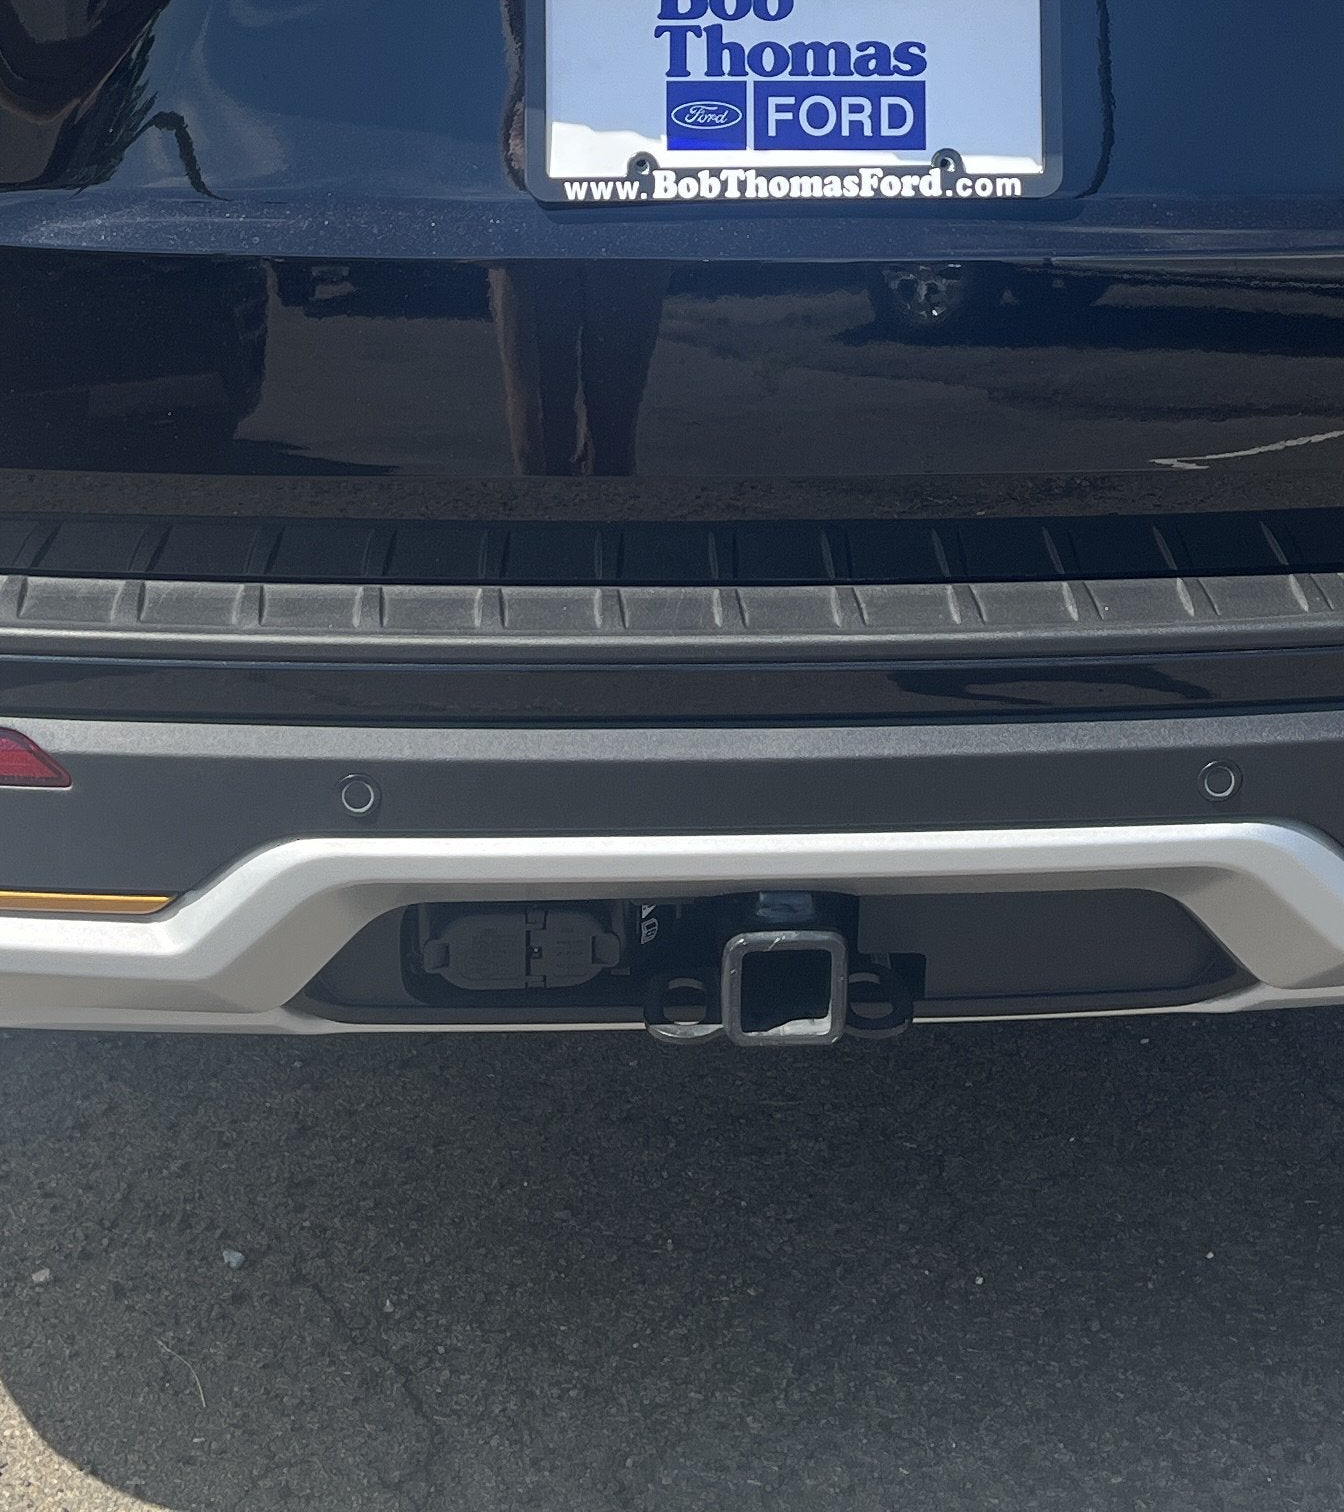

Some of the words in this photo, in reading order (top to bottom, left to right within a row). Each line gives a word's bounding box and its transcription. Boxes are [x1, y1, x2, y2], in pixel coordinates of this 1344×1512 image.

[654, 23, 928, 78] Thomas
[684, 105, 729, 124] Ford
[767, 95, 915, 138] FORD
[563, 167, 1023, 201] www.BobThomasFord.com
